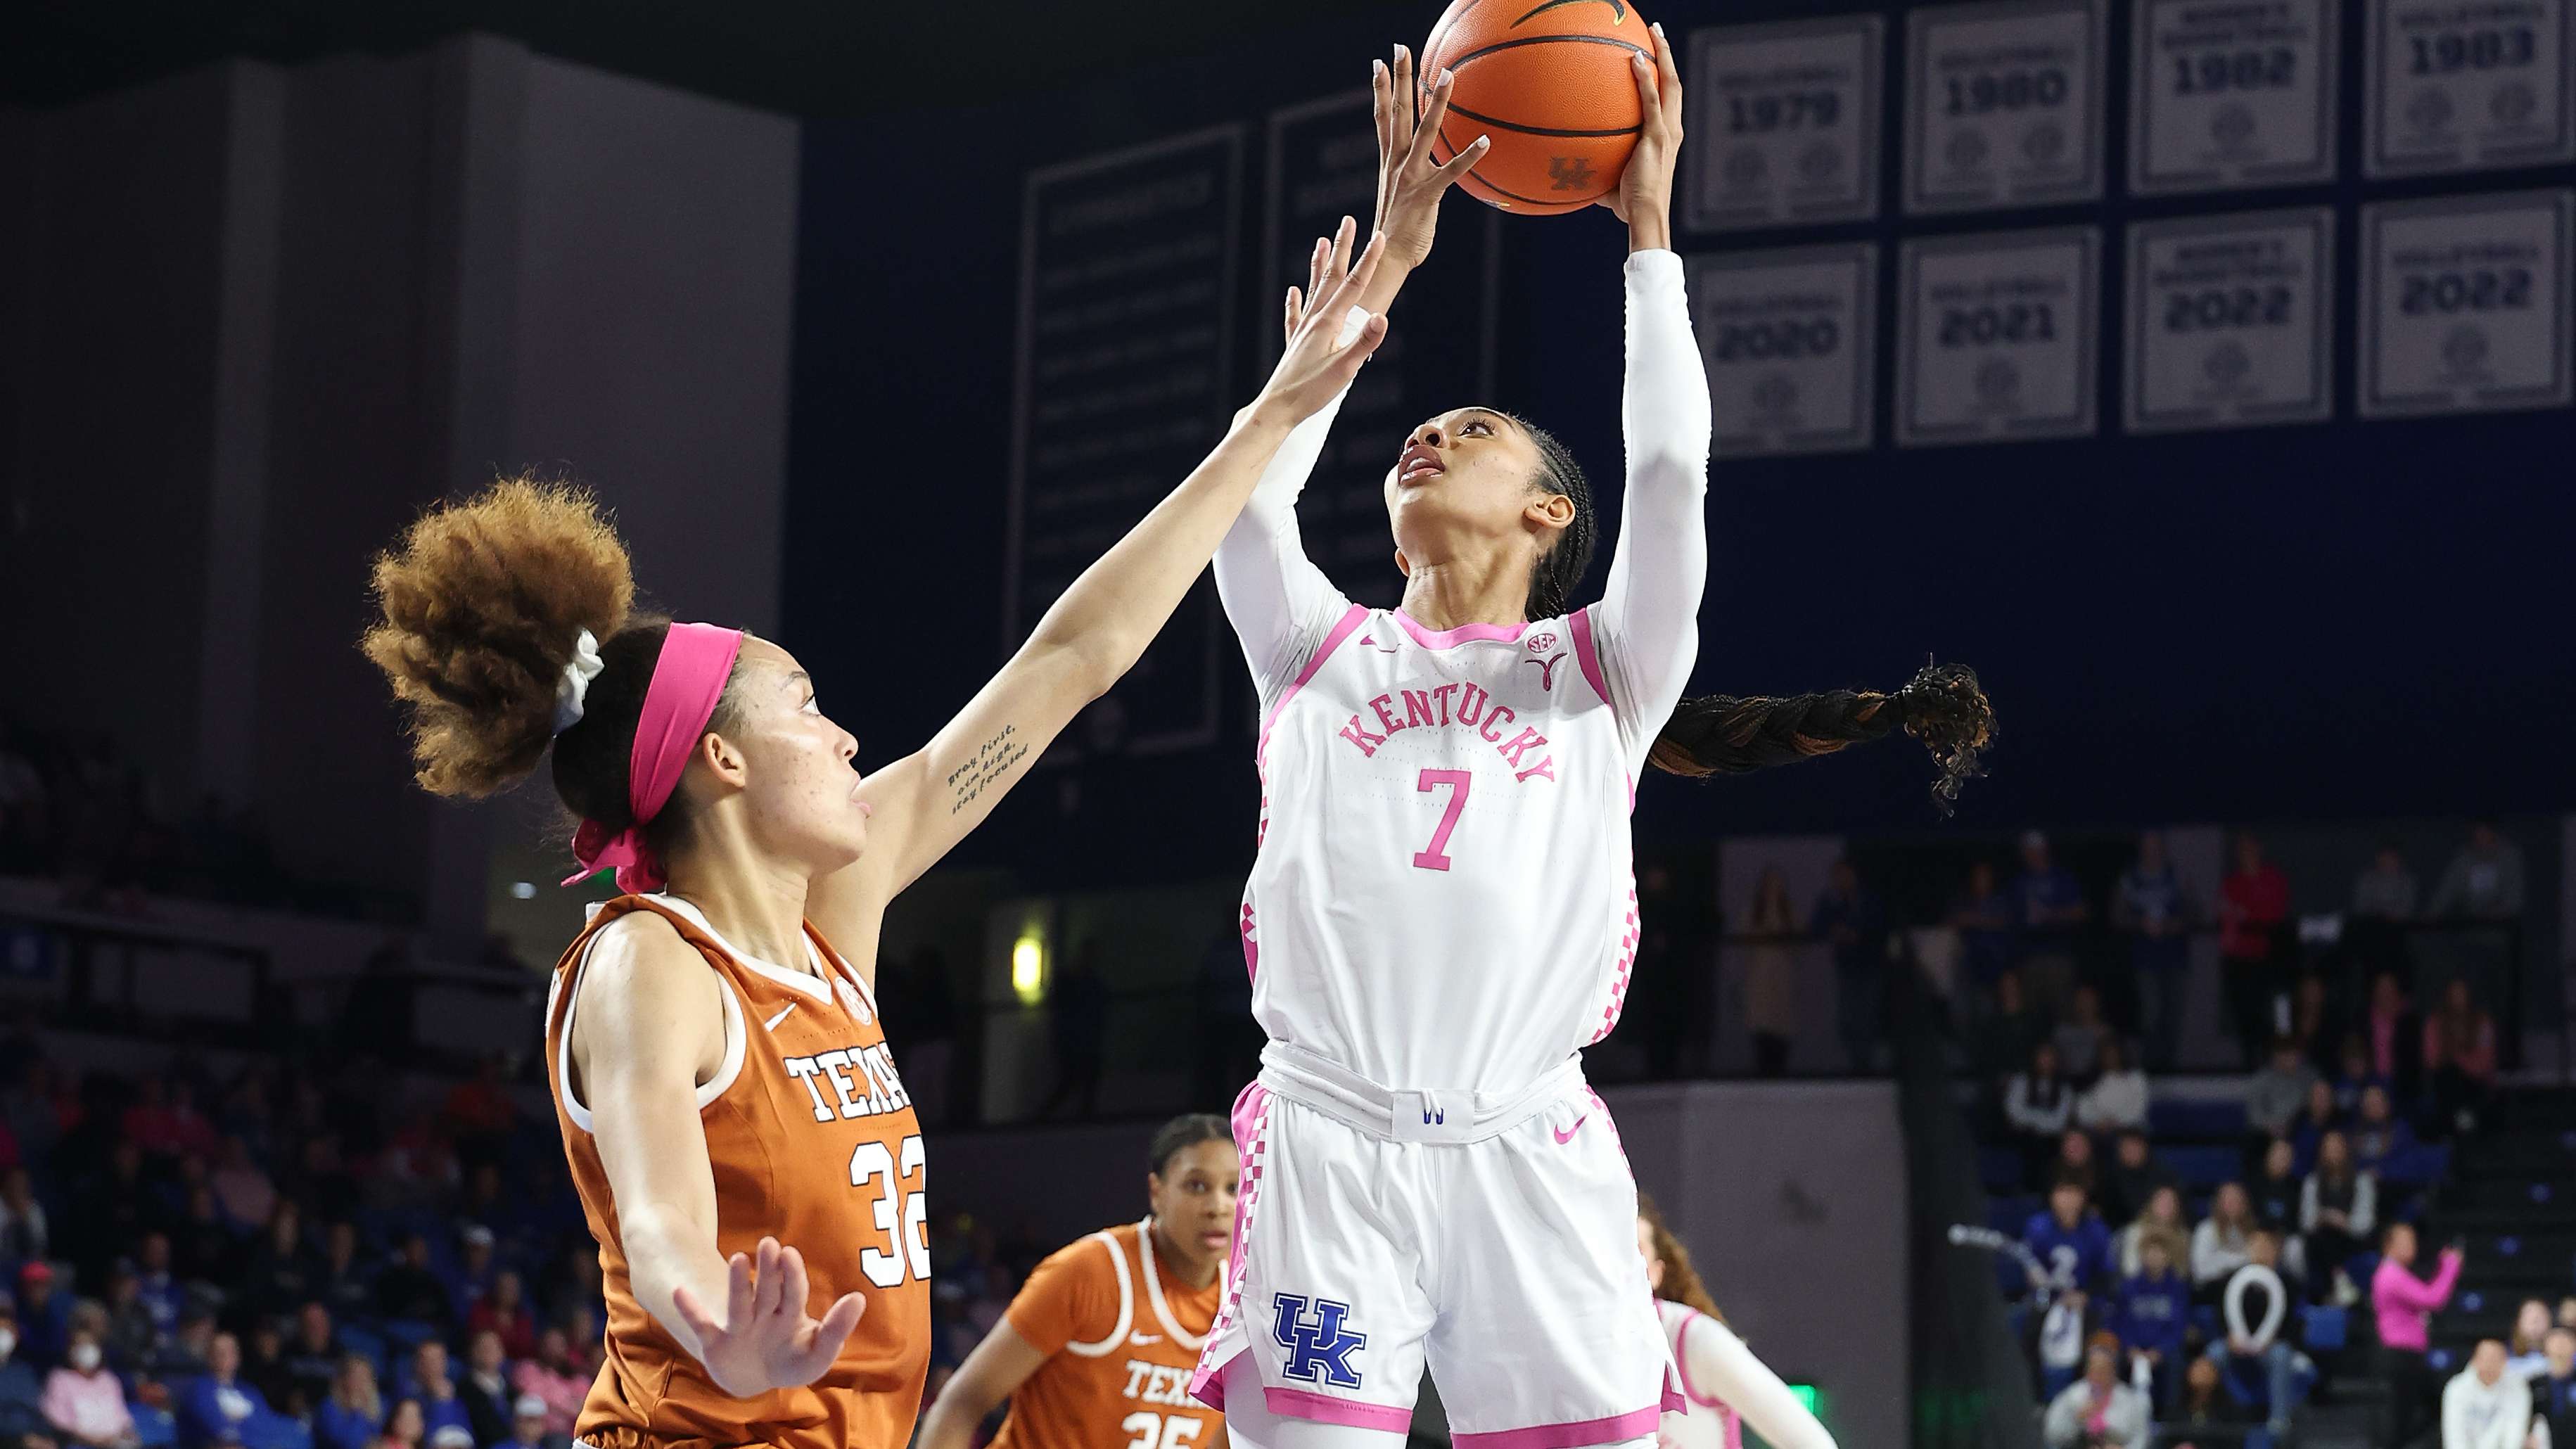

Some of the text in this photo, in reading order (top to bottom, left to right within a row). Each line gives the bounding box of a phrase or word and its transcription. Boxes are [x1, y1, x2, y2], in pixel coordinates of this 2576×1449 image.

[2175, 47, 2295, 96] 1982
[2409, 27, 2535, 76] 1983
[1728, 91, 1841, 134] 1979
[1947, 70, 2067, 118] 1980
[2165, 285, 2293, 334] 2022
[2400, 267, 2532, 317] 2022
[1714, 318, 1839, 364] 2020
[1938, 301, 2055, 348] 2021
[1339, 681, 1555, 784] KENTUCKY
[948, 757, 977, 786] pray
[1413, 768, 1472, 872] 7
[784, 1041, 912, 1123] TEXA
[849, 1135, 931, 1288] 32
[1273, 1291, 1367, 1390] UK
